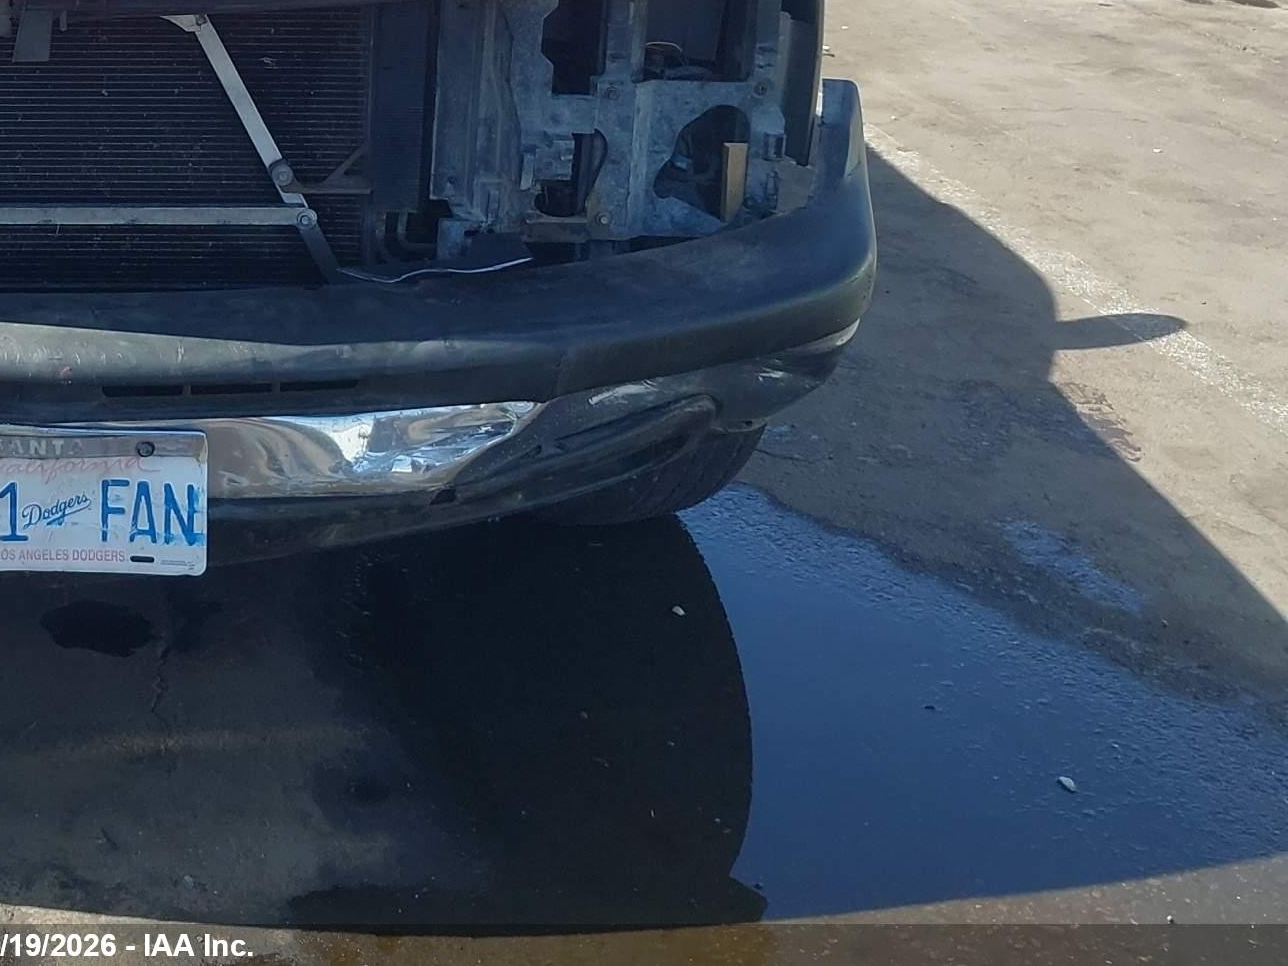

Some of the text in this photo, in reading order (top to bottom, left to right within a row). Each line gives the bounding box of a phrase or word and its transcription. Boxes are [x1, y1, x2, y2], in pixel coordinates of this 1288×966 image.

[22, 493, 91, 529] Dodgers
[101, 479, 202, 546] FAN
[19, 549, 69, 562] ANGELES
[72, 549, 126, 563] DODGERS
